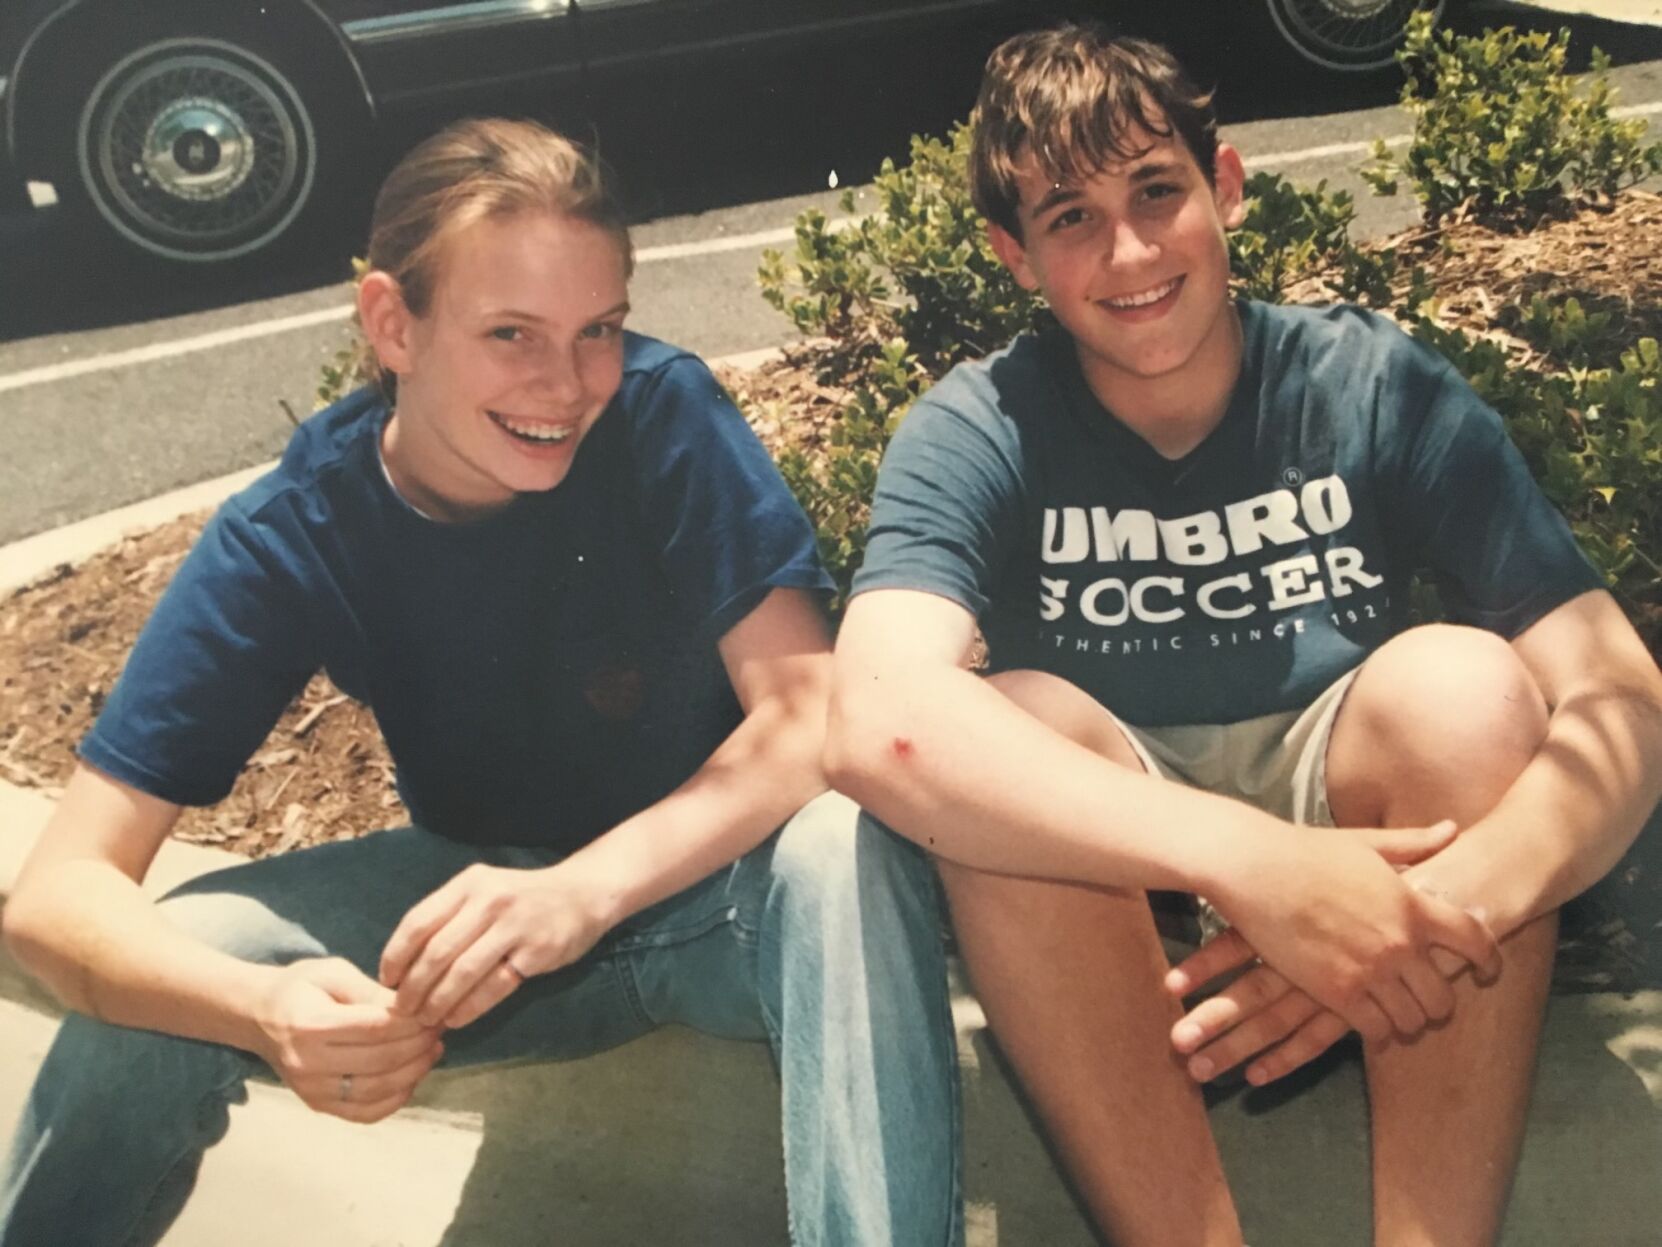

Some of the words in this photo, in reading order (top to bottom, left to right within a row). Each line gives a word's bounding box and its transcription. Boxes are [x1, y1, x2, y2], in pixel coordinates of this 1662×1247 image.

[1041, 473, 1353, 565] UMBRO
[1039, 546, 1384, 626] SOCCER
[1210, 619, 1305, 646] SINCE
[1331, 597, 1391, 626] 192
